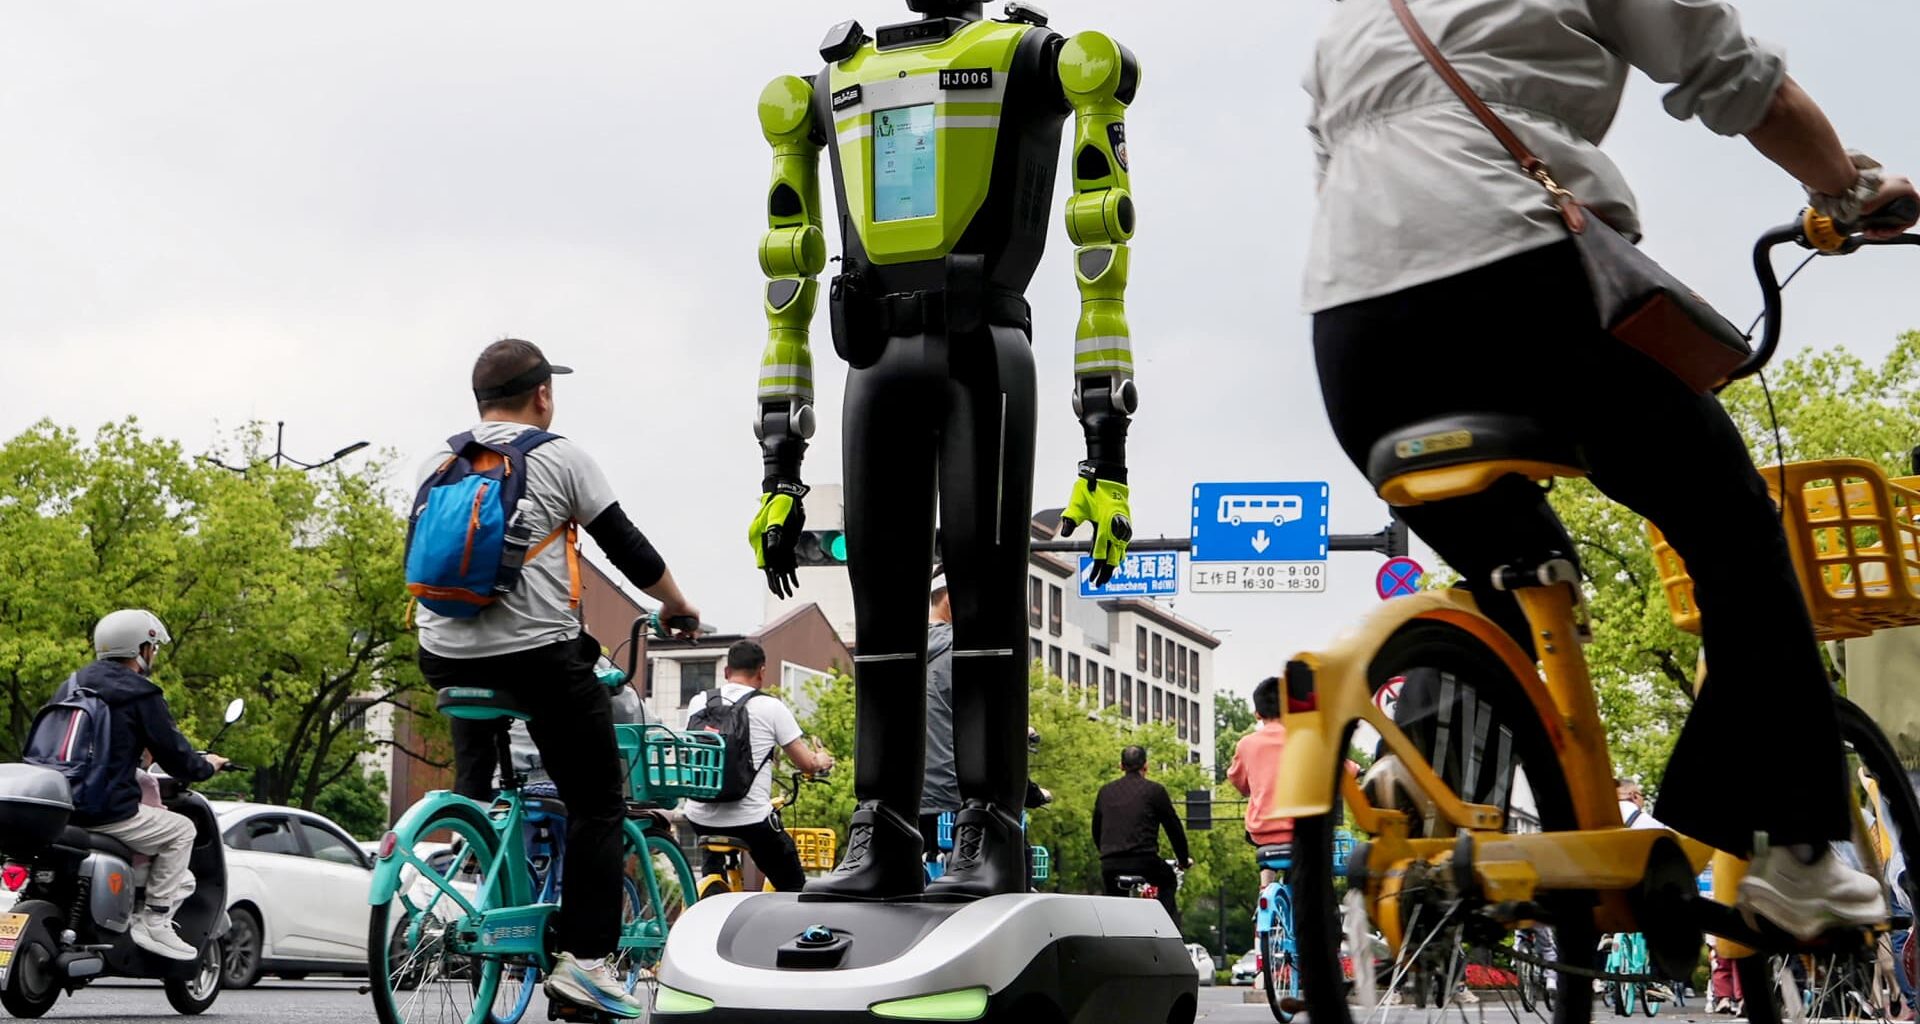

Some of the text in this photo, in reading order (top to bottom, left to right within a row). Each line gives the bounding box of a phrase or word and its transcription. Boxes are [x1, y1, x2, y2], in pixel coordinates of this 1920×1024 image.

[942, 72, 988, 85] HJ006
[1196, 570, 1237, 585] 工作日
[1105, 582, 1148, 594] Huancheng
